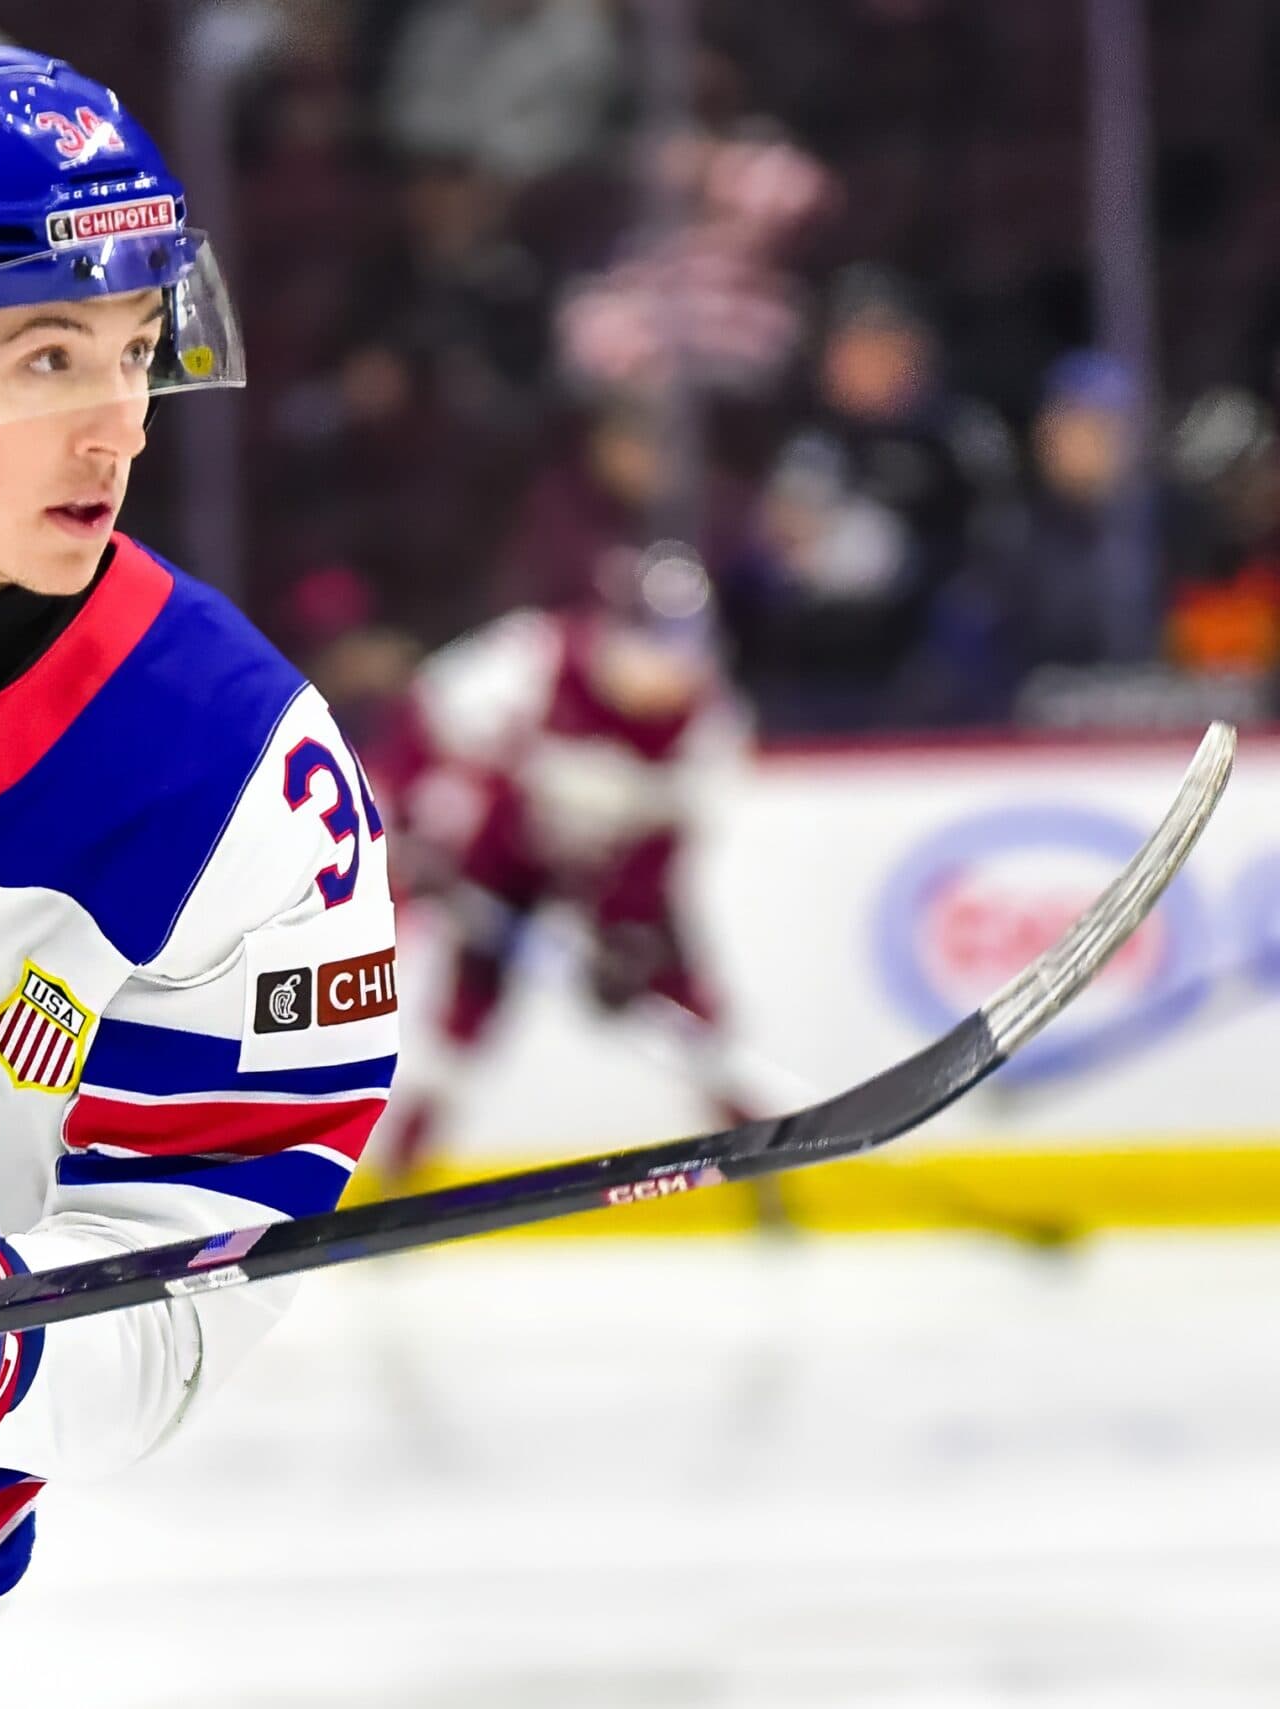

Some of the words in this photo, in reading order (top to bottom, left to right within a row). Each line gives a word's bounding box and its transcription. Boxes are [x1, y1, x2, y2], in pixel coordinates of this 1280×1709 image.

[35, 106, 125, 158] 34
[78, 203, 169, 236] CHIPOTLE
[31, 980, 73, 1027] USA
[328, 959, 398, 1011] CHI
[607, 1174, 688, 1205] CCM
